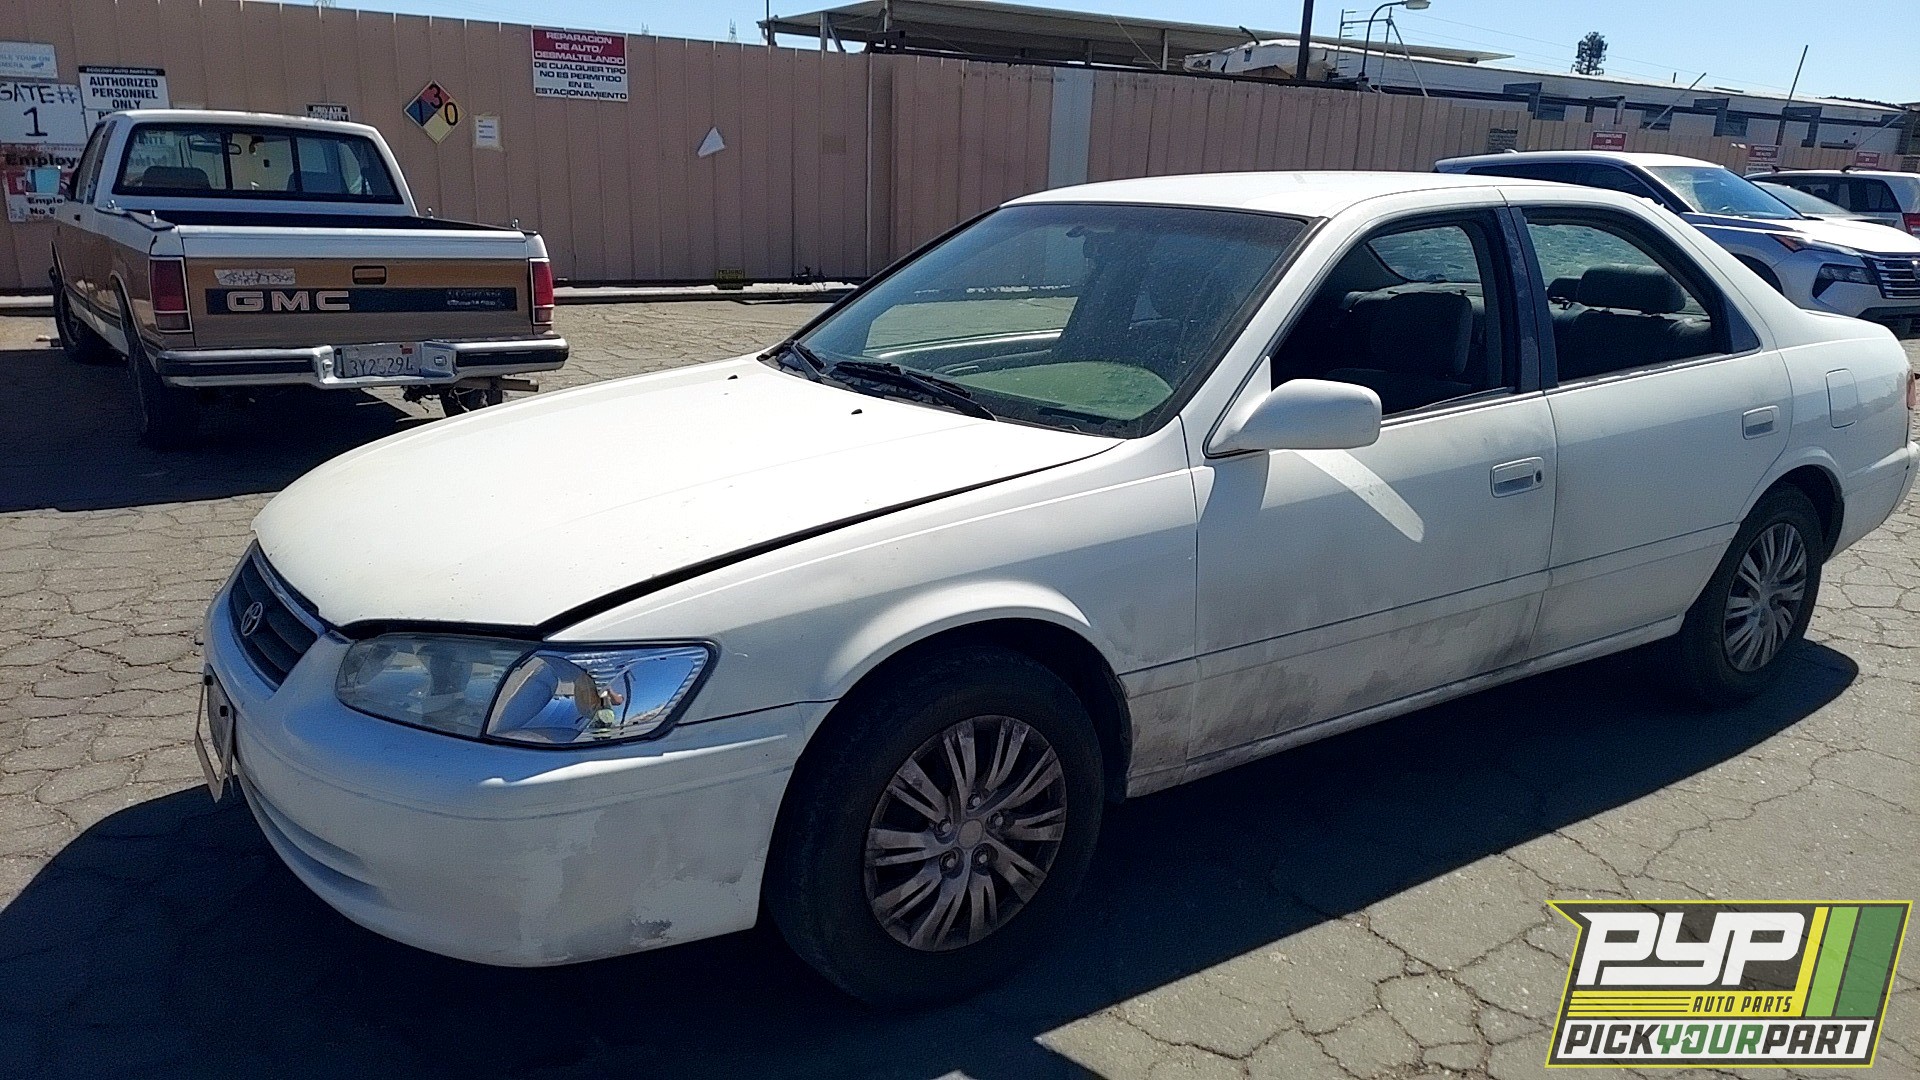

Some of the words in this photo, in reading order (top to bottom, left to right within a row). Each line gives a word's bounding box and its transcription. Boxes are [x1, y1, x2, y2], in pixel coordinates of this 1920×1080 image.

[546, 32, 612, 45] REPARACION
[571, 44, 603, 53] AUTO/
[535, 51, 624, 65] DESMALTELANDO
[534, 61, 547, 69] DE
[549, 63, 604, 73] CUALQUIER
[606, 66, 626, 74] TIPO
[90, 76, 159, 88] AUTHORIZED
[571, 72, 622, 82] PERMITIDO
[92, 88, 158, 99] PERSONNEL
[429, 84, 443, 108] 3
[535, 87, 627, 99] ESTACIONAMIENTO
[112, 99, 141, 109] ONLY
[445, 102, 458, 126] 0
[23, 106, 48, 137] 1
[27, 197, 64, 205] Emplo
[227, 291, 350, 312] GMC
